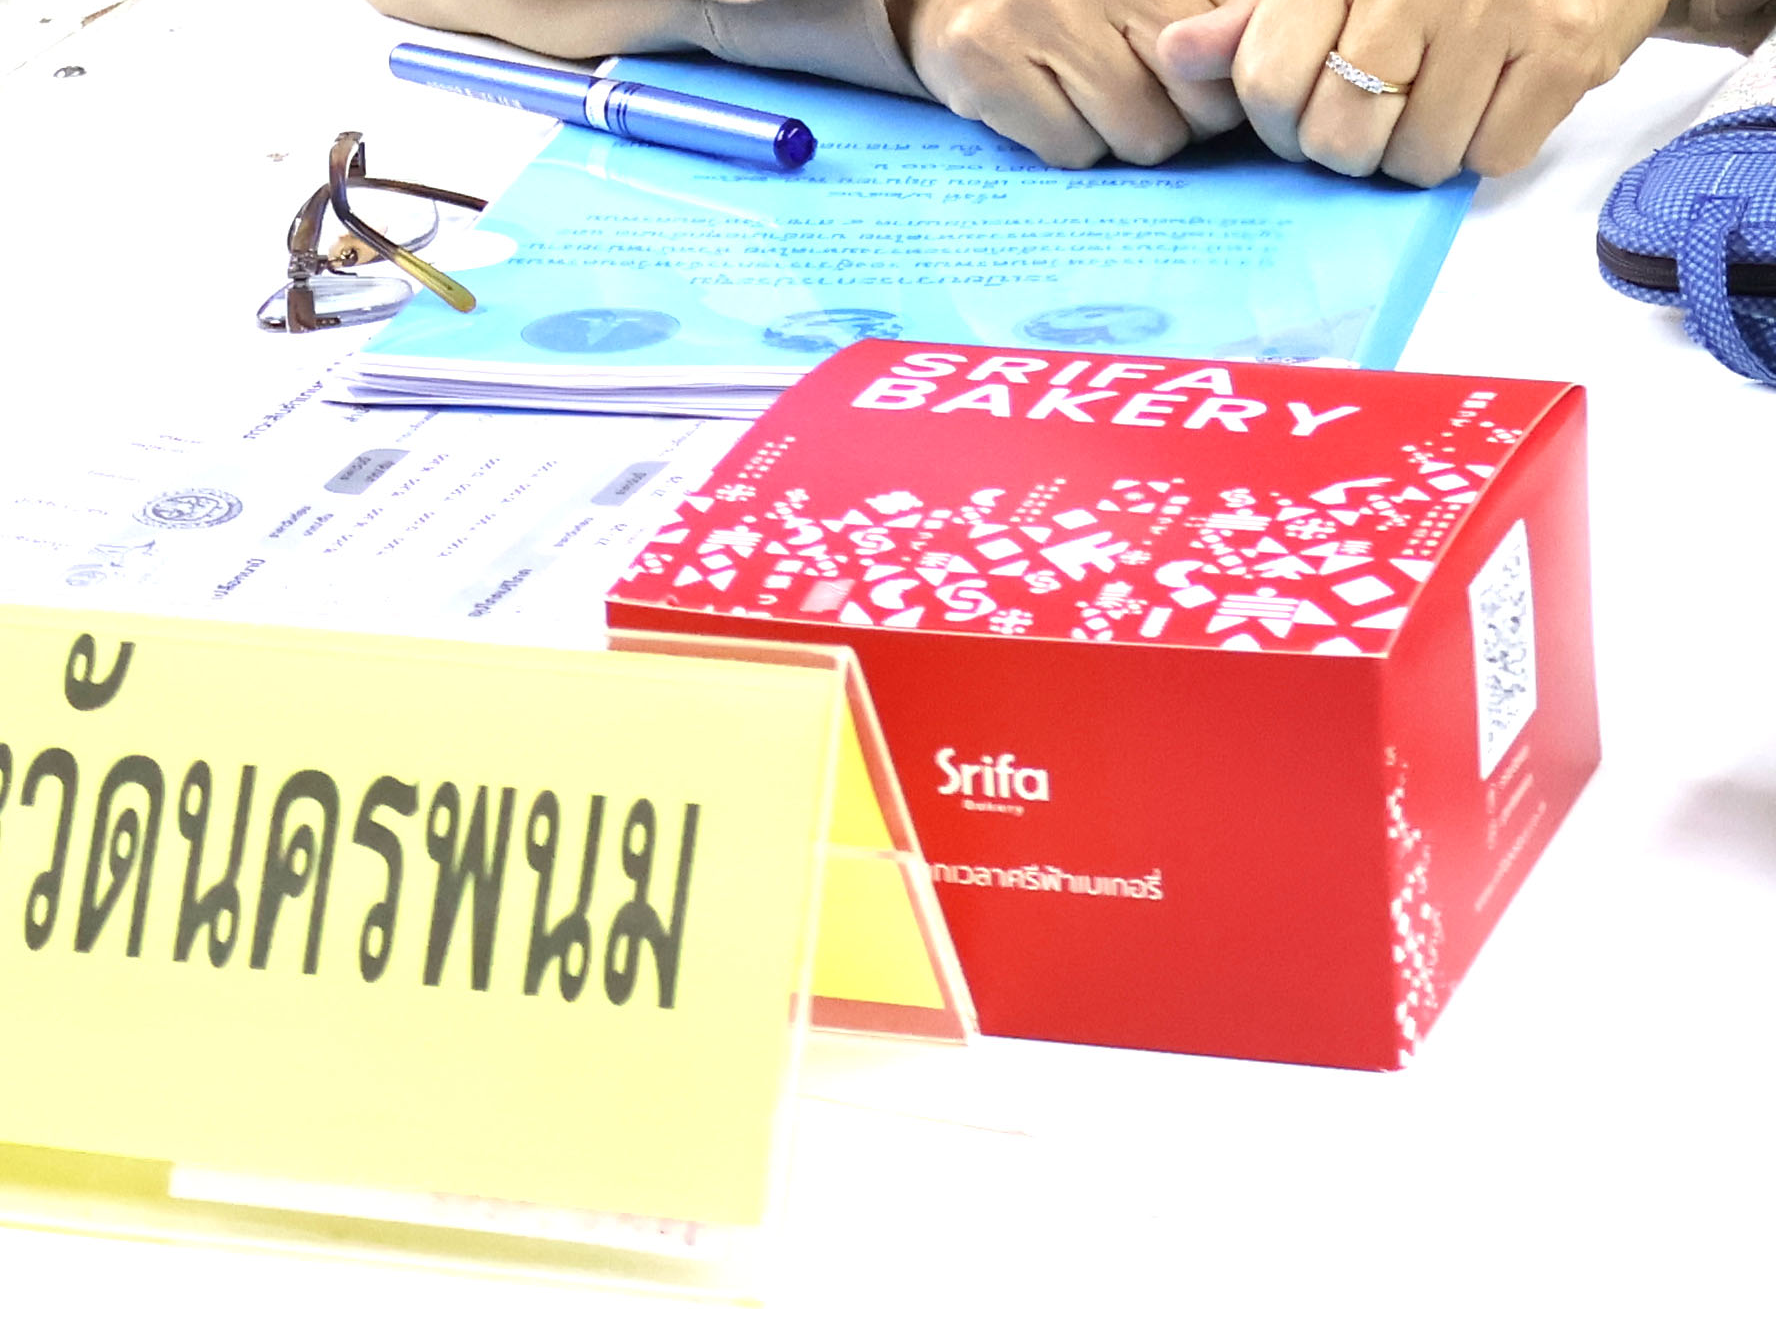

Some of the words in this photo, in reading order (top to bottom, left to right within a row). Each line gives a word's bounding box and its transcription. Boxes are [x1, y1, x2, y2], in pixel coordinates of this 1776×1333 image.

[891, 351, 1235, 395] SRIFA
[851, 377, 1362, 436] BAKERY
[934, 747, 1051, 802] Srifa
[928, 861, 1164, 901] กเวลาศรีฟ้าเบเกอรี่
